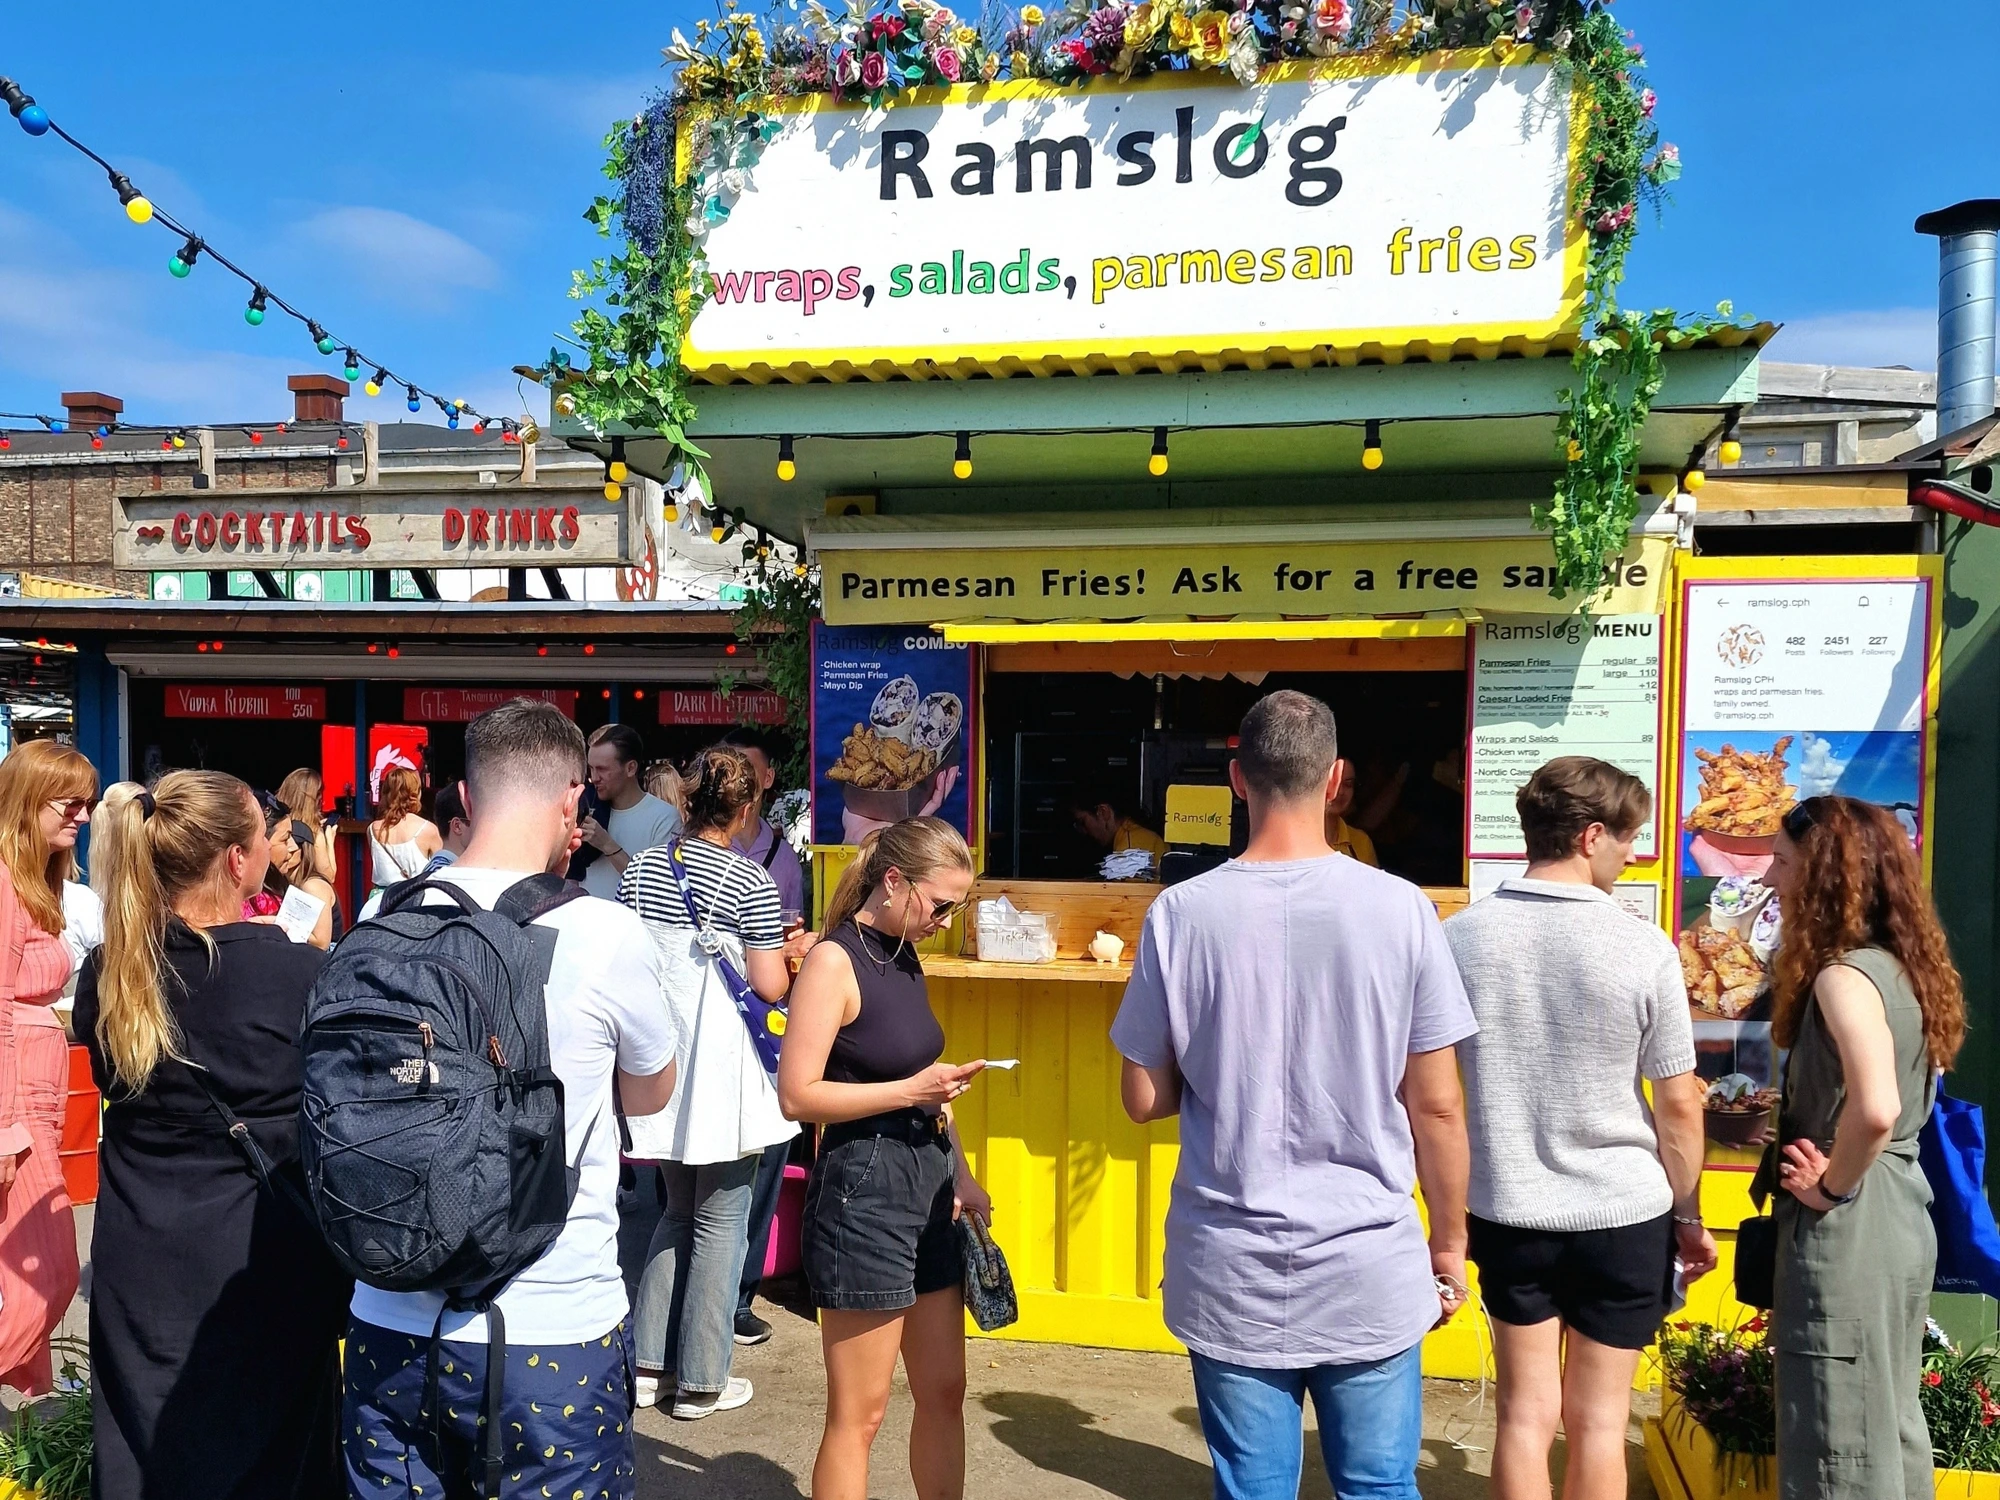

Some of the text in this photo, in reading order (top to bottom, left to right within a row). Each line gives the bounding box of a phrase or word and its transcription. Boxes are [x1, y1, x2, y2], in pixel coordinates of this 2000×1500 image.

[710, 227, 1538, 317] wraps, salads, parmesan fries
[172, 505, 581, 549] COCKTAILS DRINKS
[841, 556, 1649, 599] Parmesan Fries! Ask for a free sale
[1594, 623, 1653, 638] MENU
[1785, 636, 1888, 646] 482 2451 227
[859, 662, 881, 671] wrap
[1479, 656, 1658, 668] Parmesan Fries regular 59
[867, 671, 889, 679] Fries
[1602, 669, 1628, 679] large
[1639, 669, 1657, 677] 110
[1754, 675, 1775, 684] CPH
[848, 682, 863, 691] Dip
[285, 688, 301, 701] 100
[1713, 688, 1739, 697] wraps
[1741, 688, 1758, 696] and
[1759, 688, 1802, 697] parmesan
[1478, 695, 1514, 704] Caesar
[1515, 694, 1549, 703] Loaded
[1551, 694, 1574, 702] Fries
[292, 704, 313, 718] 550
[1475, 735, 1506, 744] Wraps
[1509, 735, 1526, 743] and
[1528, 734, 1559, 743] Salads
[1517, 749, 1541, 757] wrap
[401, 1059, 421, 1067] THE
[389, 1067, 423, 1076] NORTH
[397, 1075, 421, 1084] FACE
